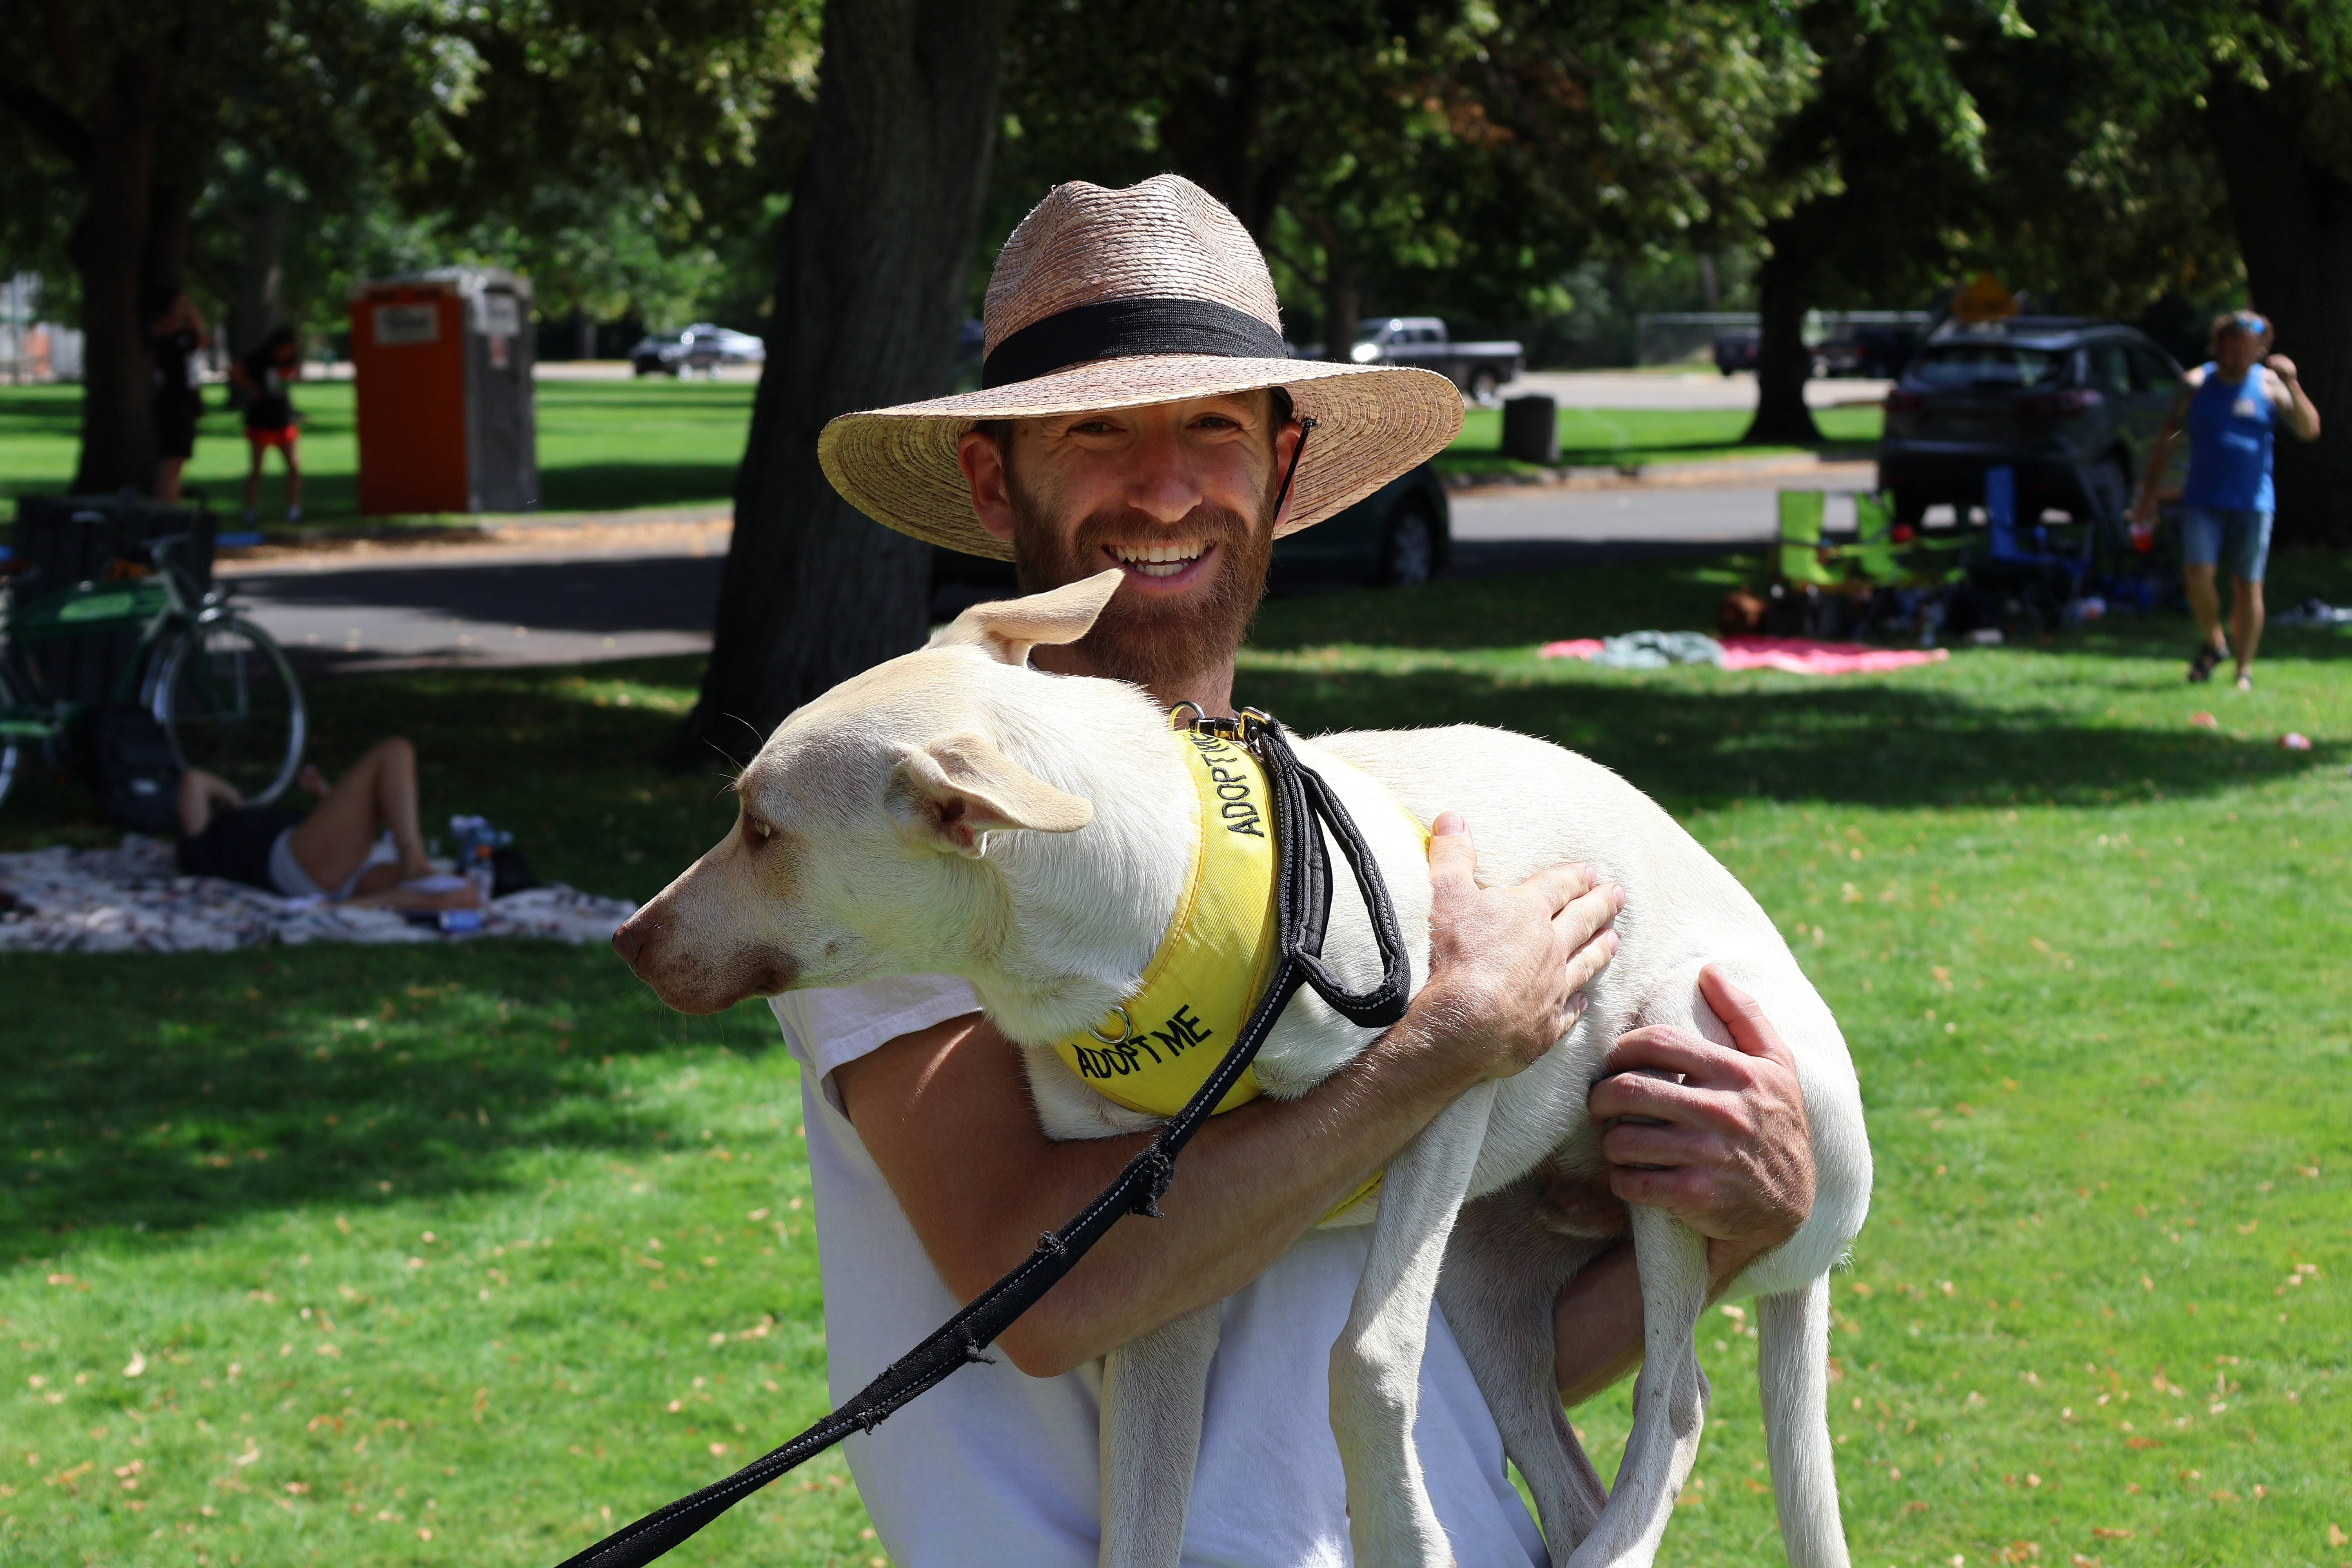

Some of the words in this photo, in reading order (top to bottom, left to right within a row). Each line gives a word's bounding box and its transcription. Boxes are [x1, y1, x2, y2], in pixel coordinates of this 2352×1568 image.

[1201, 753, 1265, 838] ADOPT
[1071, 1034, 1162, 1079] ADOPT
[1149, 1004, 1213, 1057] ME
